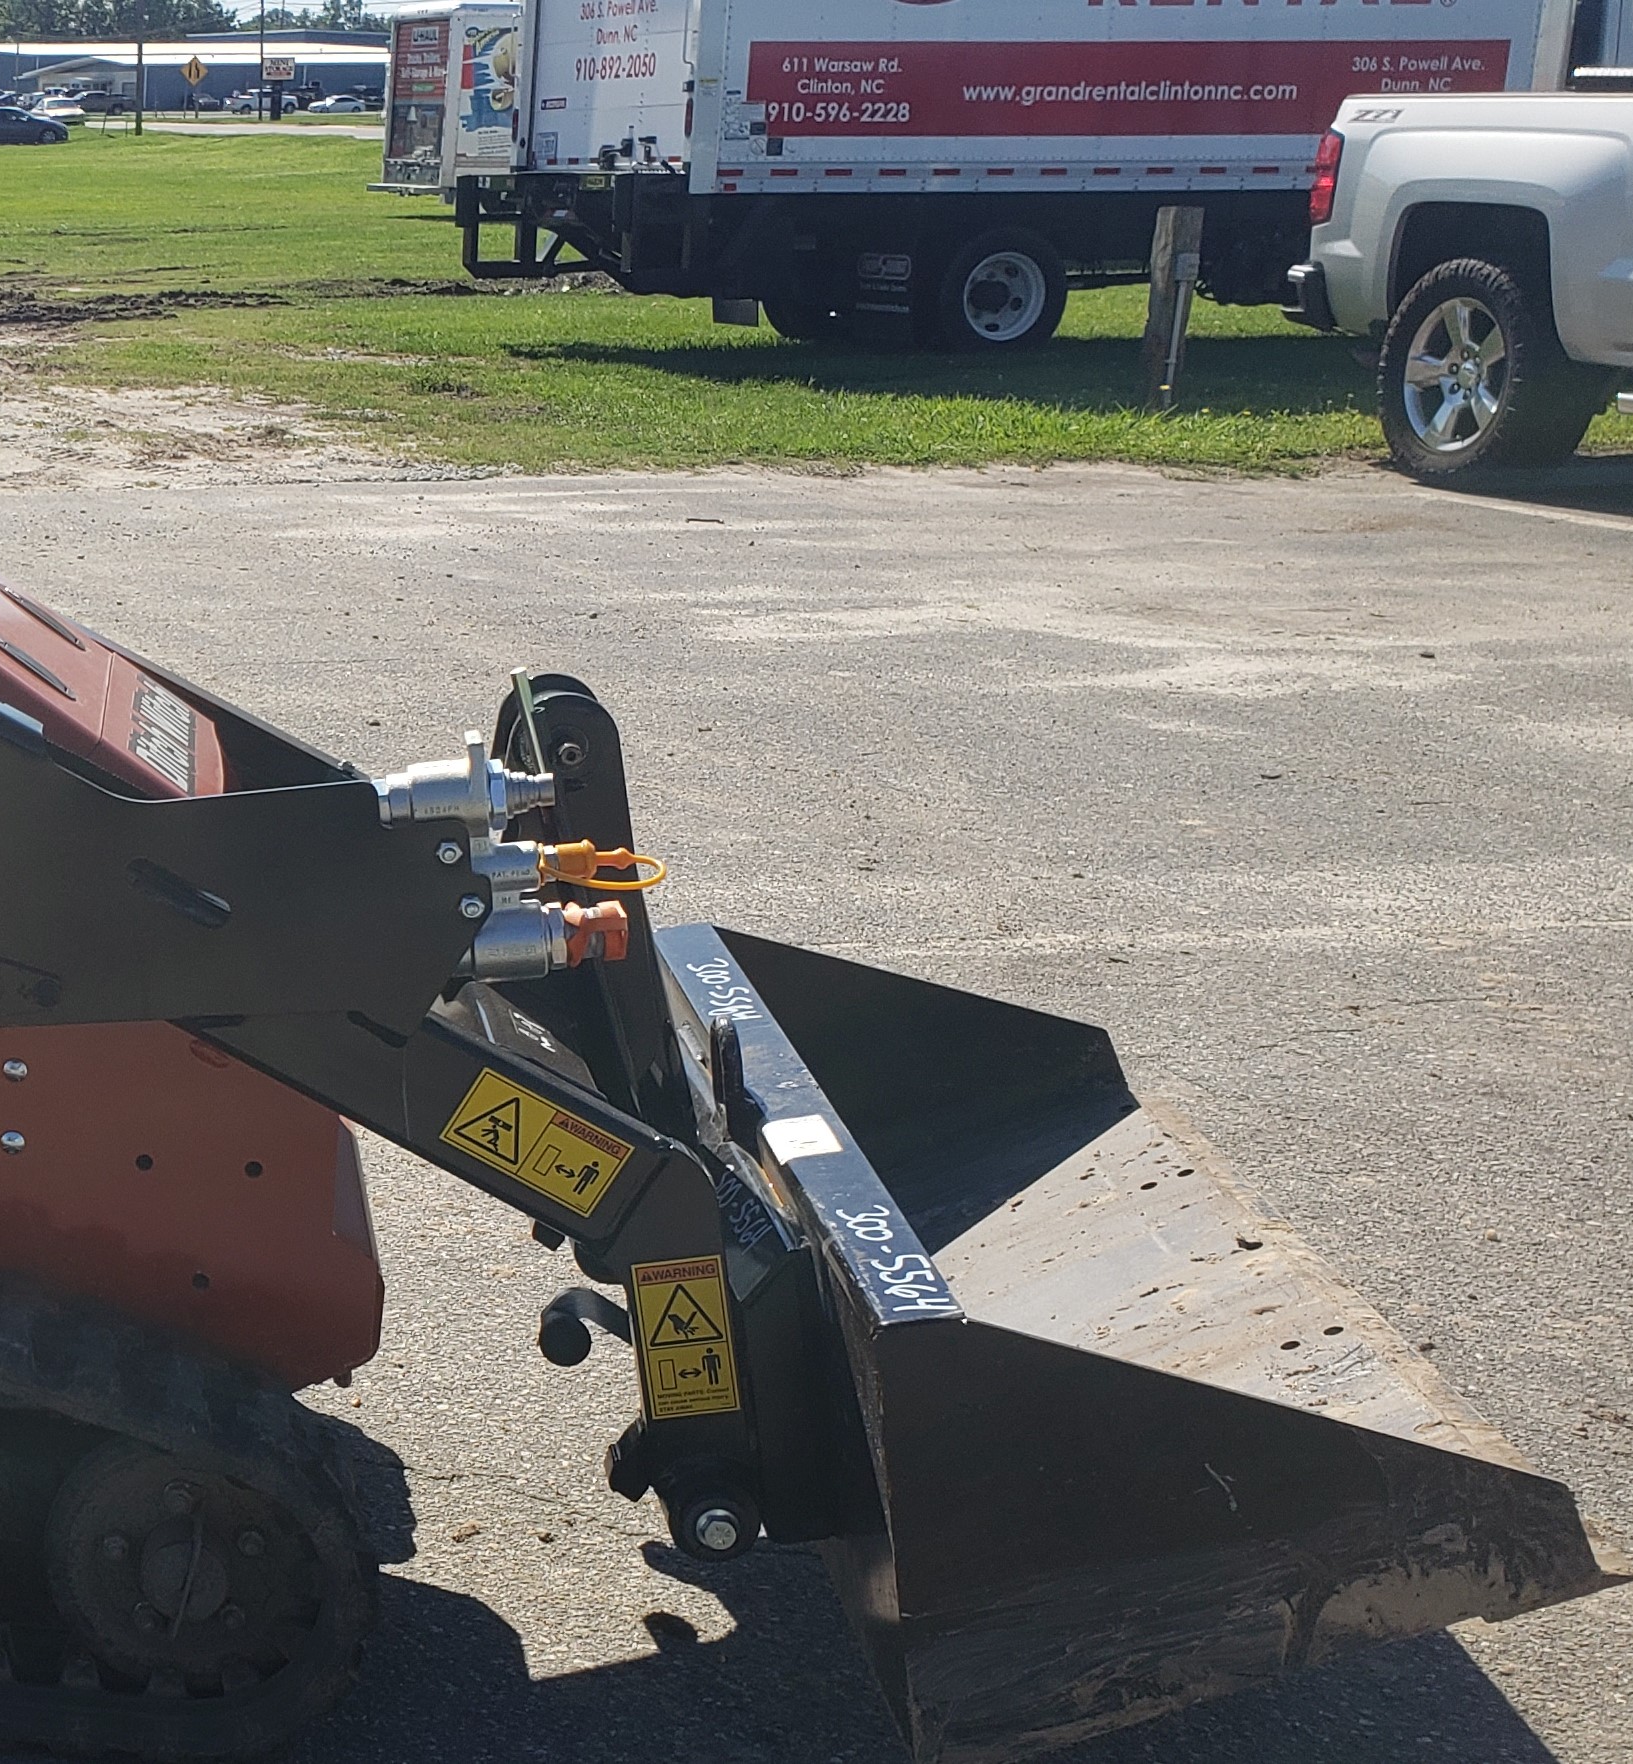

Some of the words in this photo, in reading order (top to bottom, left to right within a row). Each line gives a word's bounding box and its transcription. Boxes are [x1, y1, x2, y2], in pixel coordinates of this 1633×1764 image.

[579, 4, 595, 20] 306
[607, 0, 635, 17] Powell
[638, 0, 659, 13] Ave.
[624, 25, 638, 42] NC
[575, 52, 657, 81] 910-892-2050
[782, 57, 808, 73] 611
[814, 57, 874, 73] Warsaw
[879, 57, 903, 73] Rd.
[1351, 56, 1378, 72] 306
[1381, 56, 1395, 72] S.
[1399, 55, 1448, 72] Powell
[1451, 55, 1486, 71] Ave.
[797, 78, 855, 96] Clinton,
[860, 79, 886, 94] NC
[1428, 76, 1453, 91] NC
[963, 80, 1298, 106] www.grandrentalclintonnc.com
[768, 101, 911, 123] 910-596-2228
[1347, 109, 1405, 124] Z71
[568, 1119, 623, 1156] WARNING
[652, 1264, 716, 1282] WARNING
